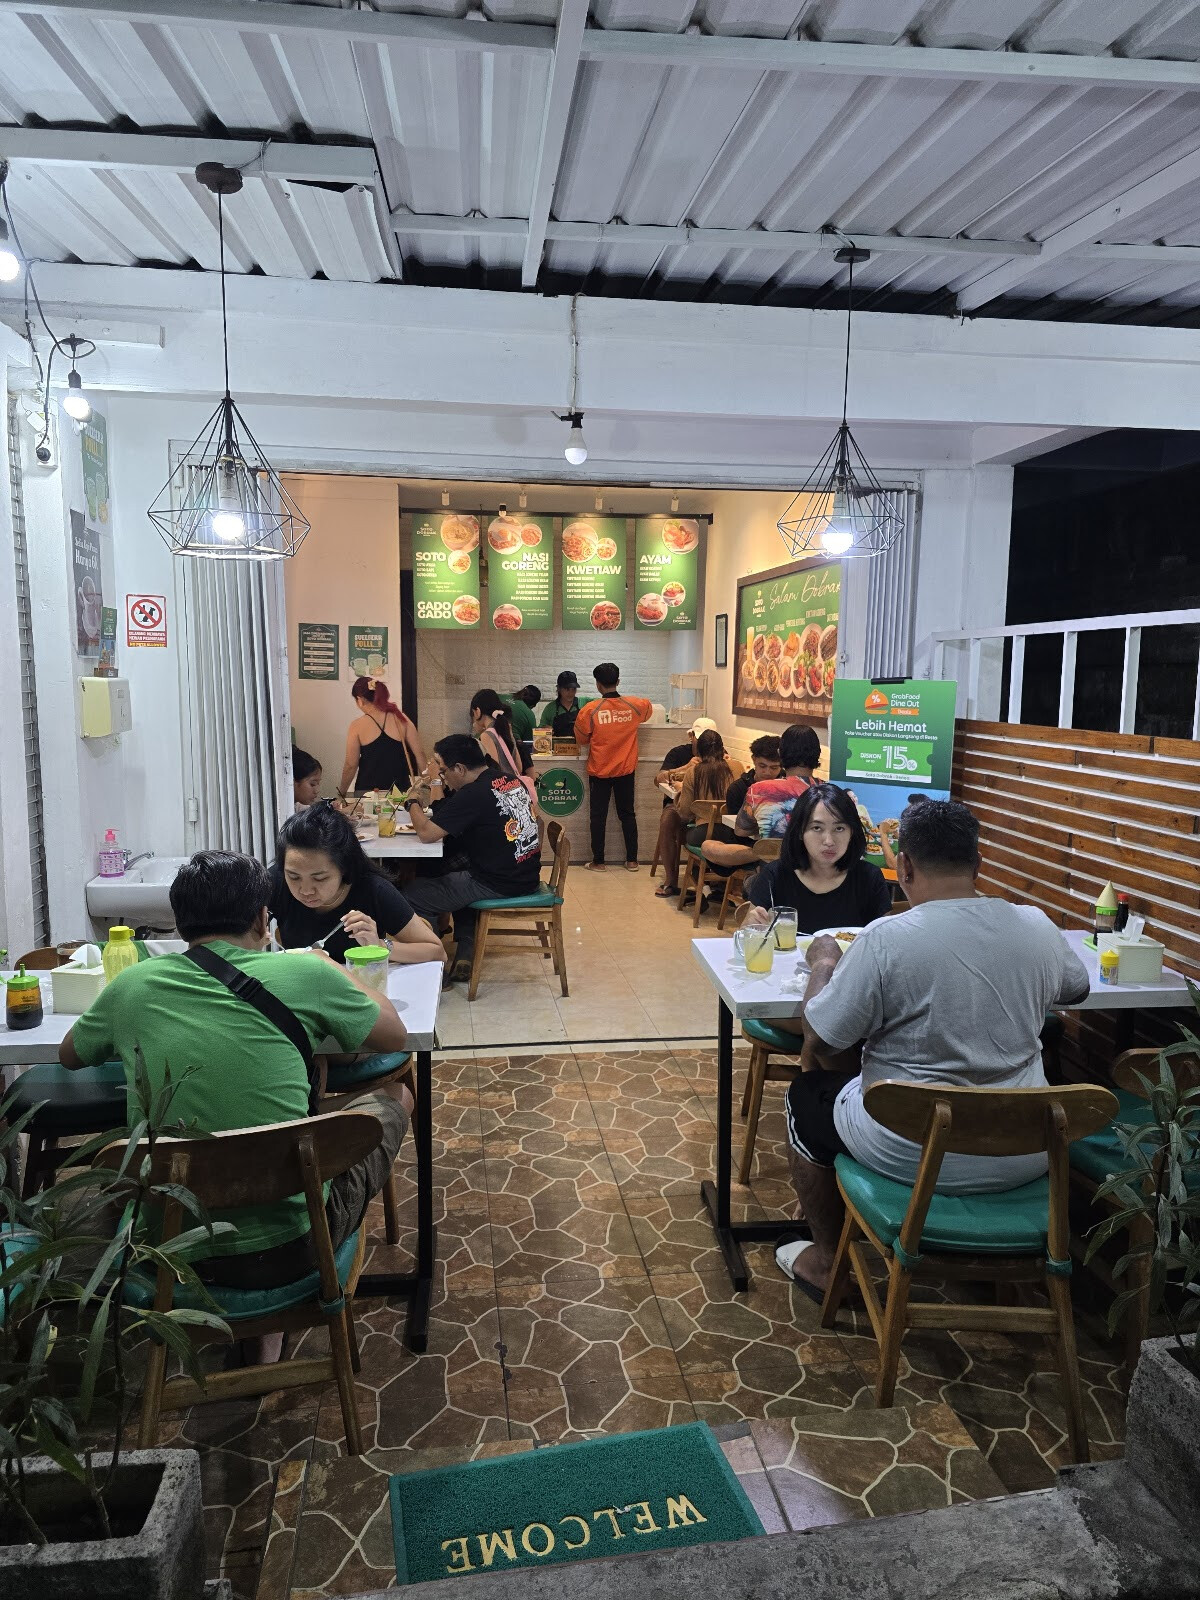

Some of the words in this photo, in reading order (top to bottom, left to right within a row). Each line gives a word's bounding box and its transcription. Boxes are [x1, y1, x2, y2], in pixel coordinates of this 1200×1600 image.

[415, 551, 447, 562] SOTO
[523, 552, 549, 562] NASI
[639, 554, 672, 565] AYAM
[502, 560, 549, 571] GORENG
[566, 565, 622, 575] KWETIAW
[417, 601, 452, 610] GADO
[417, 610, 452, 619] GADO
[890, 699, 906, 707] Dine
[906, 700, 919, 708] Out
[612, 714, 633, 723] Food
[855, 719, 886, 731] Lebih
[888, 720, 927, 733] Hemat
[860, 752, 882, 760] DISKON
[440, 1494, 708, 1574] WELCOME
